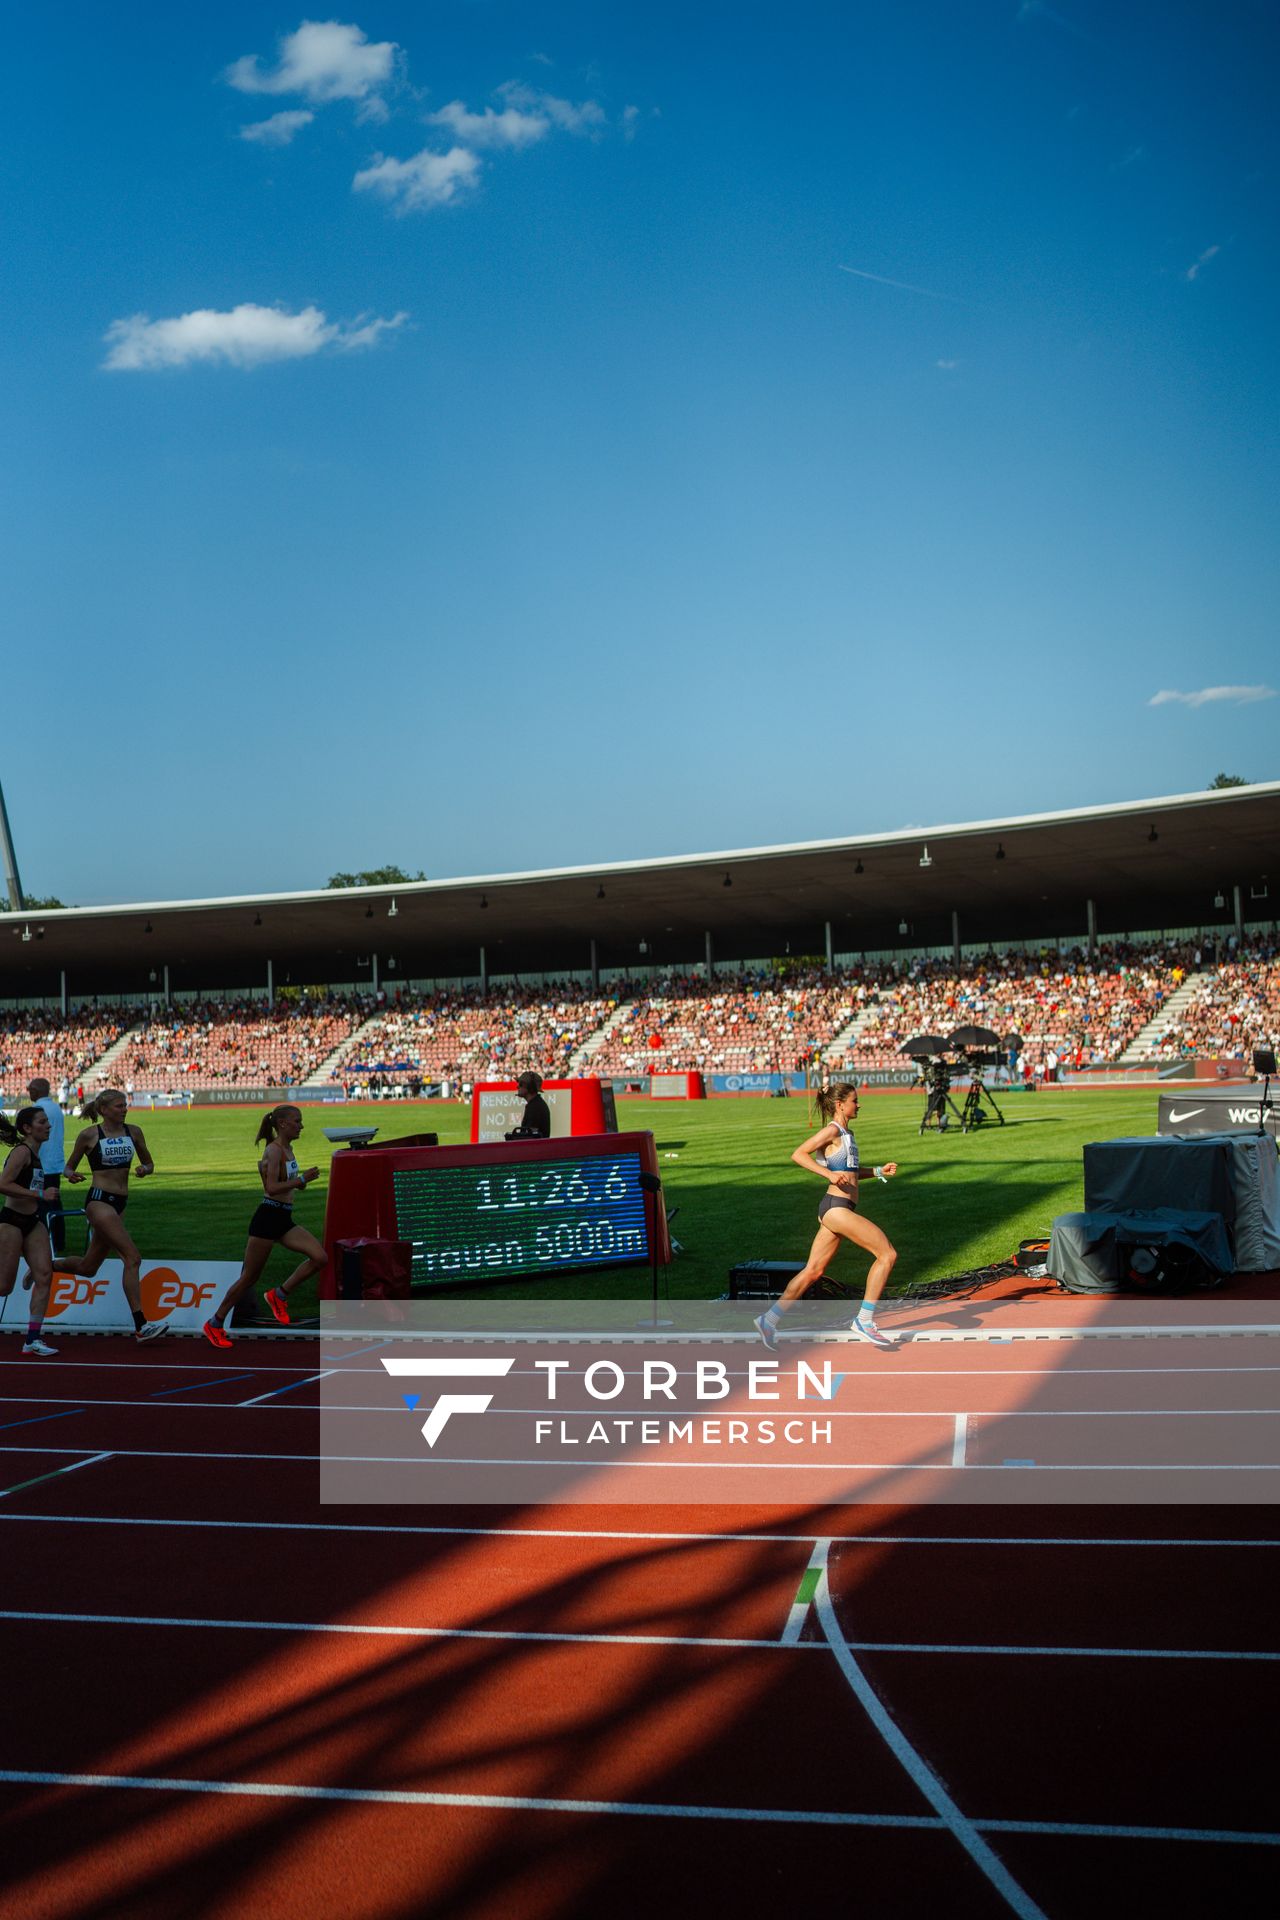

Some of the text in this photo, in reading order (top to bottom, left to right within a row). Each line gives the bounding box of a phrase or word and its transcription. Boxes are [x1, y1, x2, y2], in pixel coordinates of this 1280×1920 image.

[743, 1076, 770, 1085] PLAN
[217, 1091, 264, 1101] NOVAFON
[106, 1137, 123, 1145] GLS
[104, 1145, 132, 1156] GERDES
[476, 1164, 627, 1210] 11:26.6
[535, 1220, 643, 1260] 5000m
